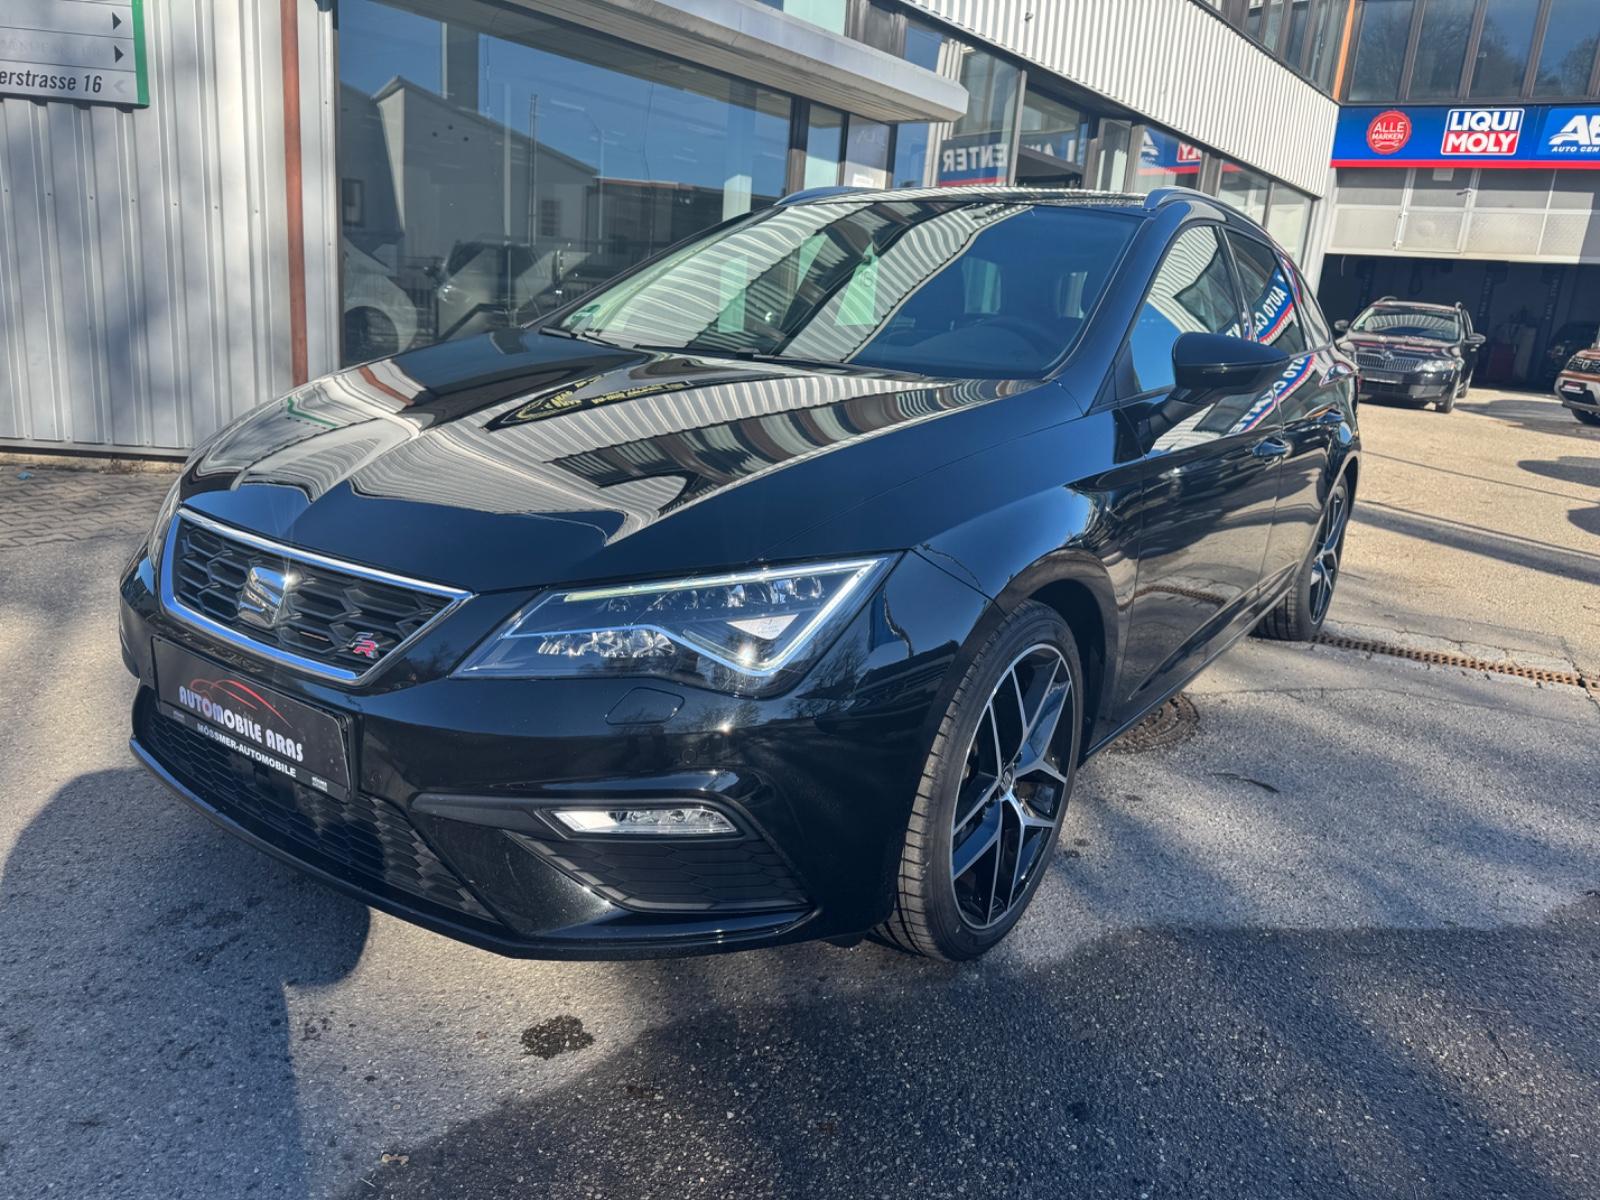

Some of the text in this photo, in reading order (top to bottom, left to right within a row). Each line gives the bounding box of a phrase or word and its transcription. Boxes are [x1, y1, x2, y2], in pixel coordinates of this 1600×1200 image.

[0, 70, 103, 94] erstrasse 16
[1373, 121, 1406, 133] ALLE
[1451, 111, 1520, 132] LIQUI
[1371, 132, 1404, 140] MARKEN
[1446, 132, 1517, 153] MOLY
[178, 685, 304, 762] AUTOMOBILE ARAS
